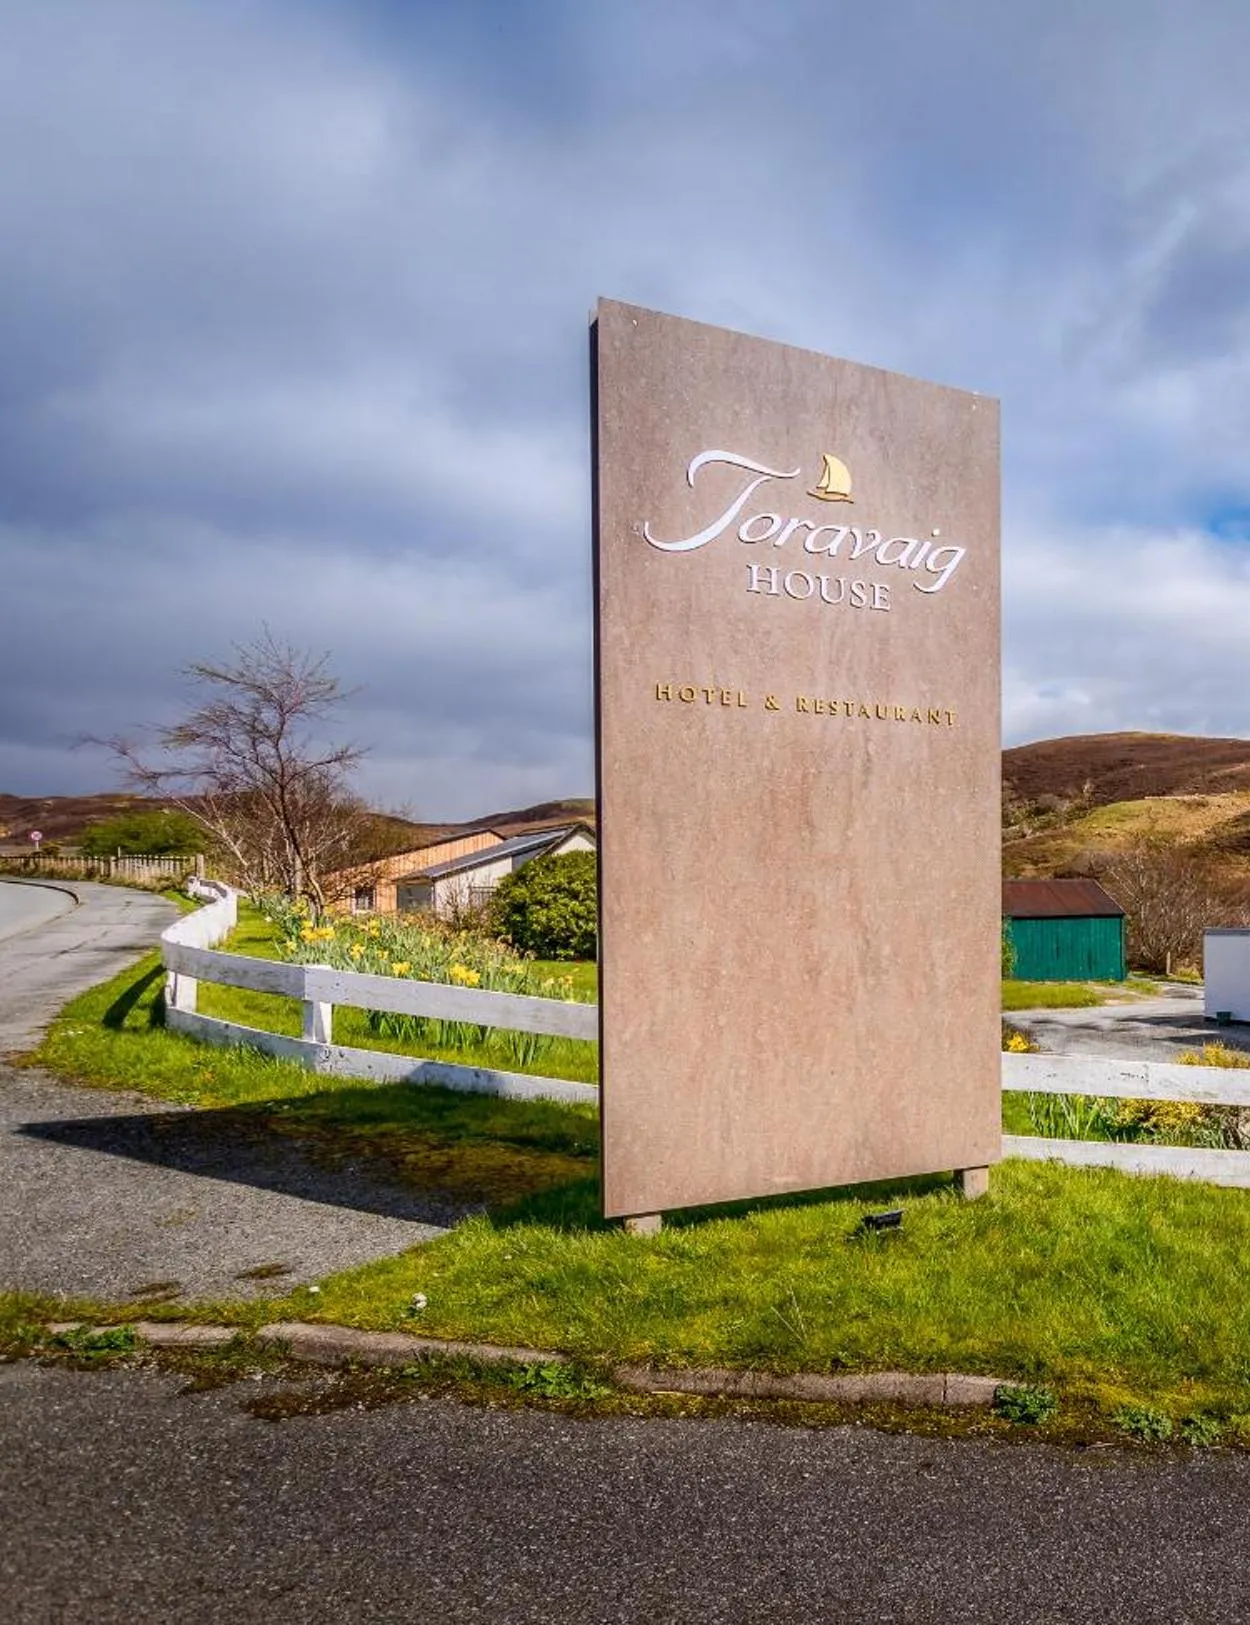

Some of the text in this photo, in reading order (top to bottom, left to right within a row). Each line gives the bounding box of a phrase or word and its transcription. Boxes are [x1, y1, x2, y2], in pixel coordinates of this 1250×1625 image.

[643, 449, 967, 593] Toravaig
[746, 563, 891, 612] HOUSE
[655, 683, 957, 726] HOTEL & RESTAURANT
